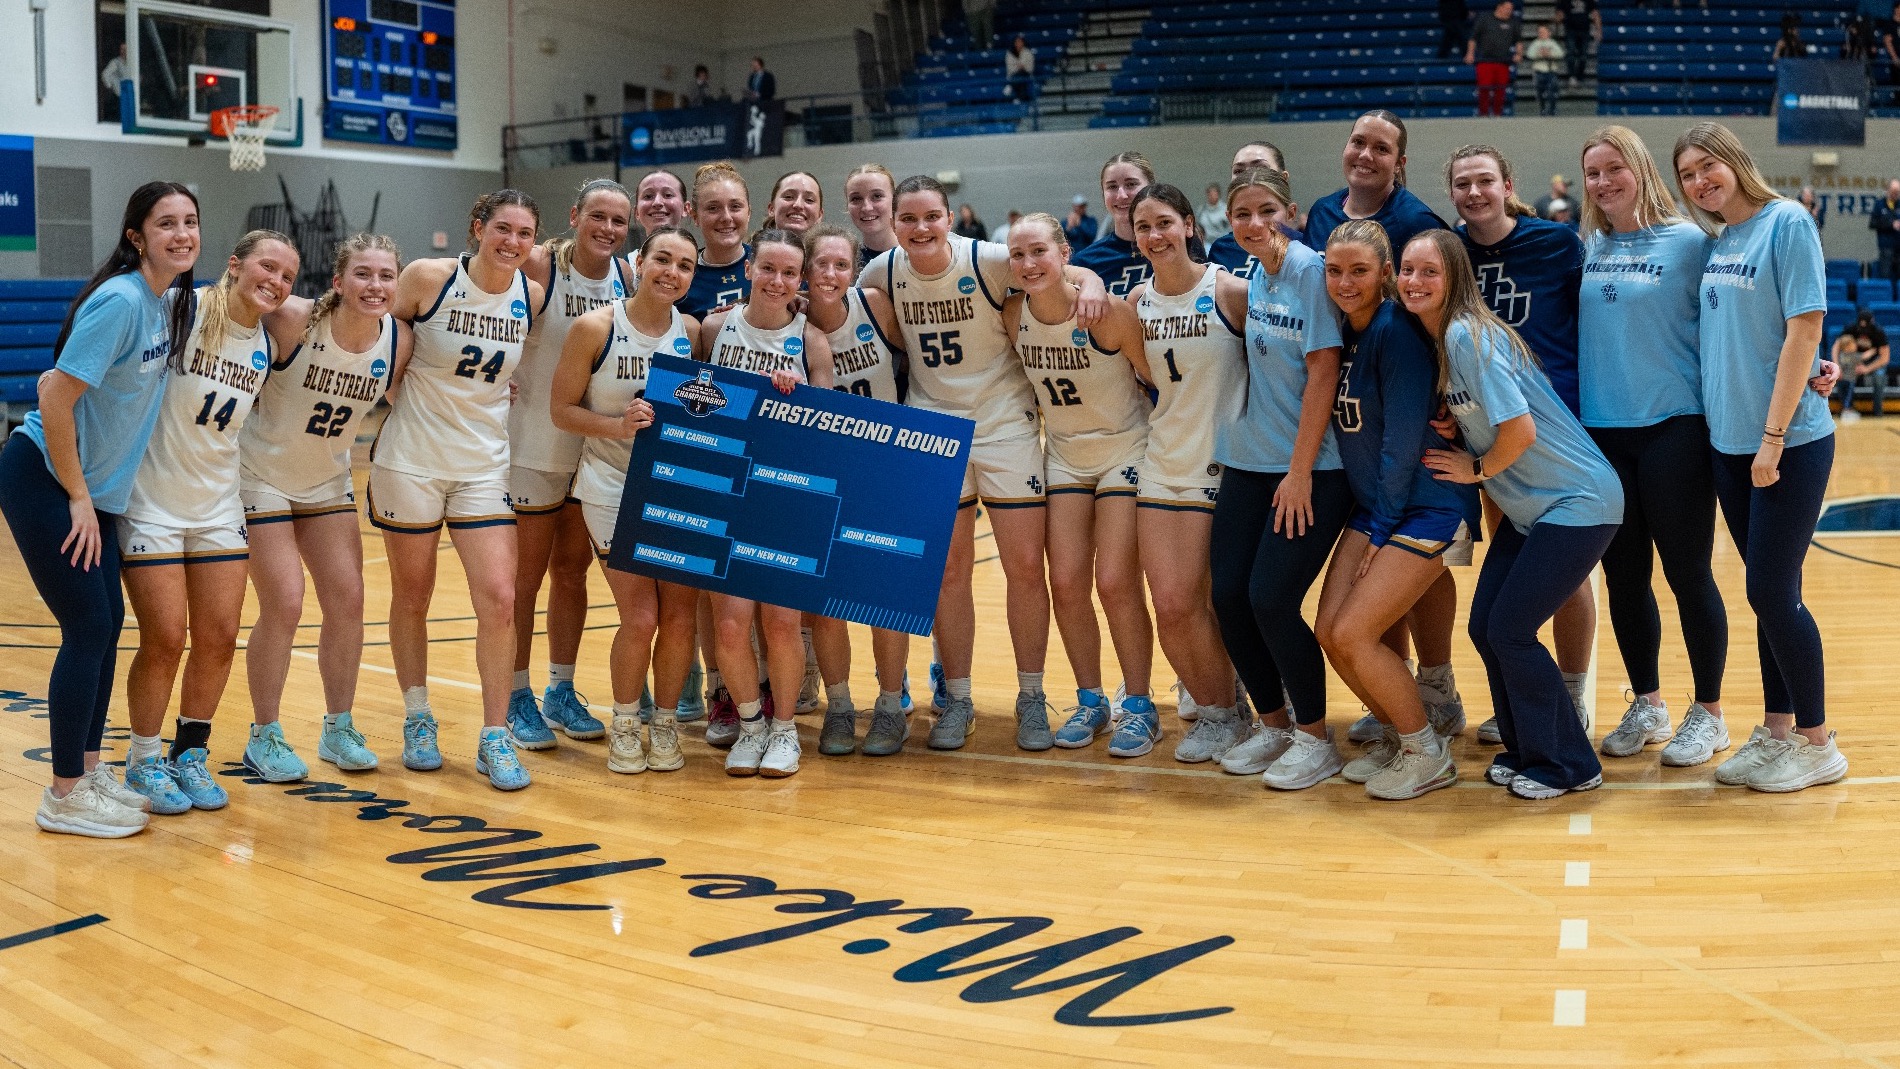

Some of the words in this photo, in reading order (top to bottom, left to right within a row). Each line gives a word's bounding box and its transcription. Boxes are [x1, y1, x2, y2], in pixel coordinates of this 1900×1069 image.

[653, 126, 711, 142] DIVISION
[0, 191, 19, 207] aks
[902, 300, 926, 326] BLUE
[927, 297, 974, 325] STREAKS
[447, 309, 477, 336] BLUE
[479, 315, 521, 344] STREAKS
[1162, 314, 1208, 341] STREAKS
[454, 344, 506, 383] 24
[718, 343, 743, 369] BLUE
[745, 350, 795, 373] STREAKS
[833, 341, 880, 377] STREAKS
[919, 330, 963, 369] 55
[1020, 344, 1043, 370] BLUE
[1045, 347, 1091, 371] STREAKS
[189, 348, 219, 381] BLUE
[219, 358, 260, 395] STREAKS
[616, 355, 644, 380] BLUE
[1163, 348, 1183, 383] 1
[302, 364, 335, 394] BLUE
[333, 372, 379, 402] STREAKS
[674, 389, 726, 406] CHAMPIONSHIP
[1041, 377, 1083, 407] 12
[195, 390, 238, 432] 14
[305, 401, 353, 439] 22
[664, 427, 686, 439] JOHN
[686, 431, 719, 447] CARROLL
[758, 399, 893, 444] FIRST/SECOND
[894, 428, 961, 458] ROUND
[655, 464, 675, 476] TCNJ
[754, 468, 777, 479] JOHN
[777, 472, 810, 486] CARROLL
[646, 506, 667, 518] SUNY
[667, 511, 686, 523] NEW
[686, 516, 709, 529] PALTZ
[842, 529, 864, 541] JOHN
[864, 533, 898, 548] CARROLL
[637, 546, 686, 565] IMMACULATA
[735, 544, 756, 557] SUNY
[757, 549, 775, 561] NEW
[775, 554, 799, 567] PALTZ
[680, 873, 1235, 1028] Mike
